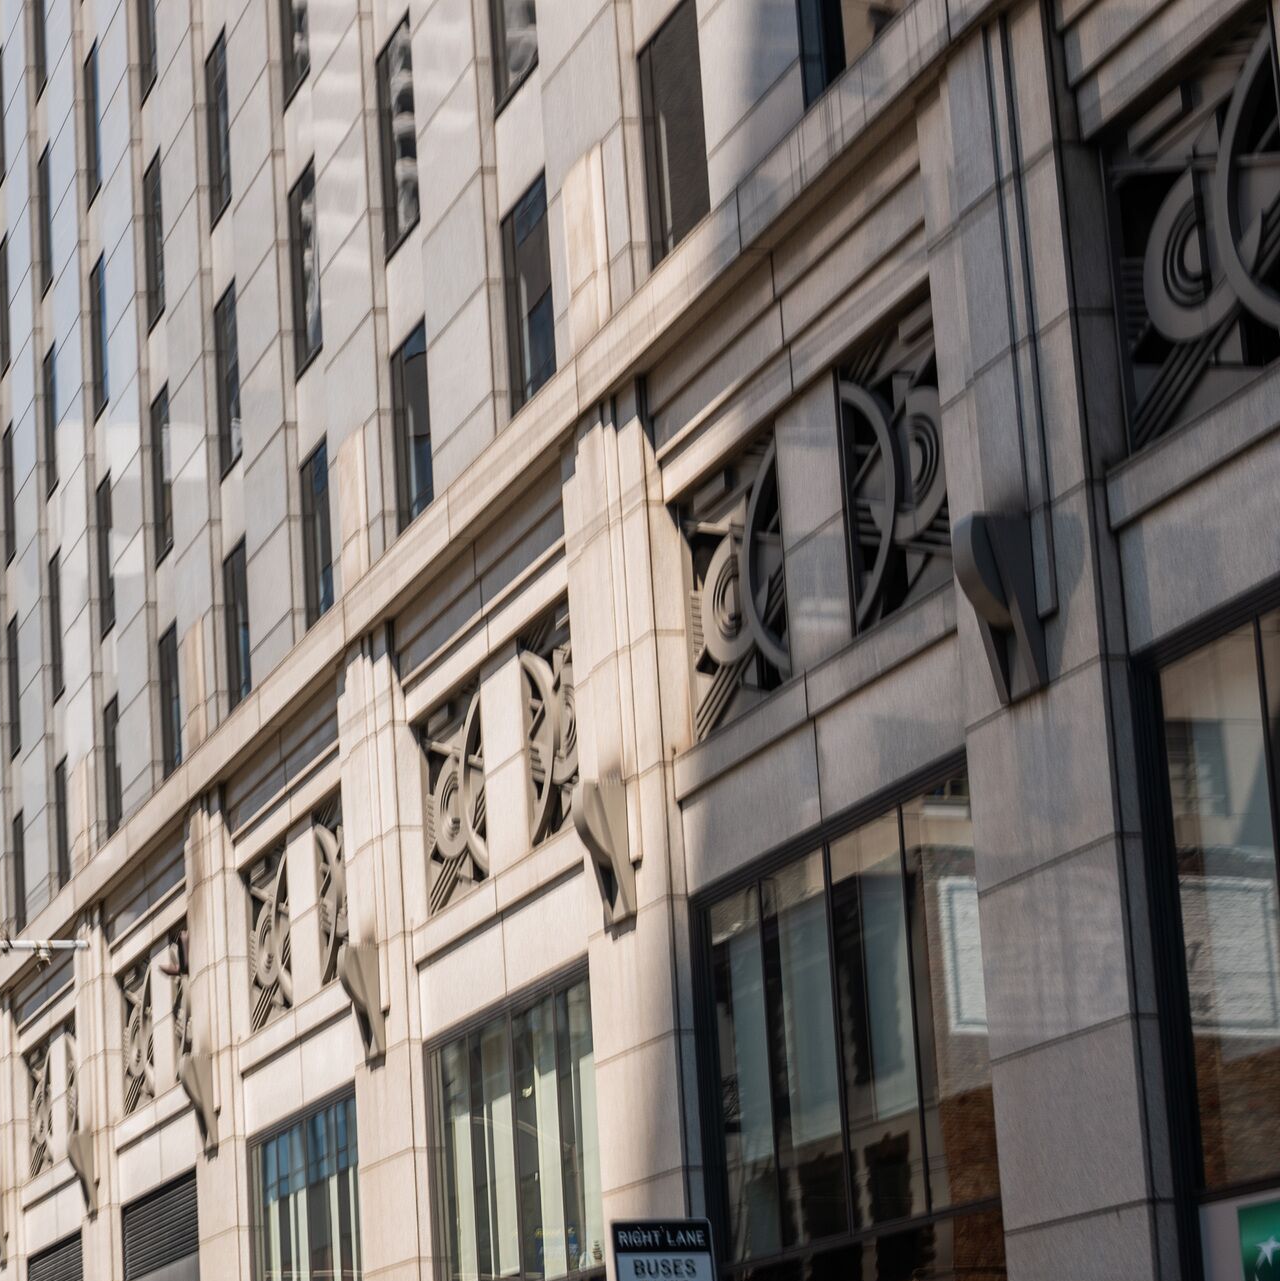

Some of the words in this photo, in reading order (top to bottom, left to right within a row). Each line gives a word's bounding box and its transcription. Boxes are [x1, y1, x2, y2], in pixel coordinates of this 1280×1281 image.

[617, 1229, 661, 1247] RIGHT
[665, 1229, 706, 1247] LANE
[632, 1258, 697, 1278] BUSES
